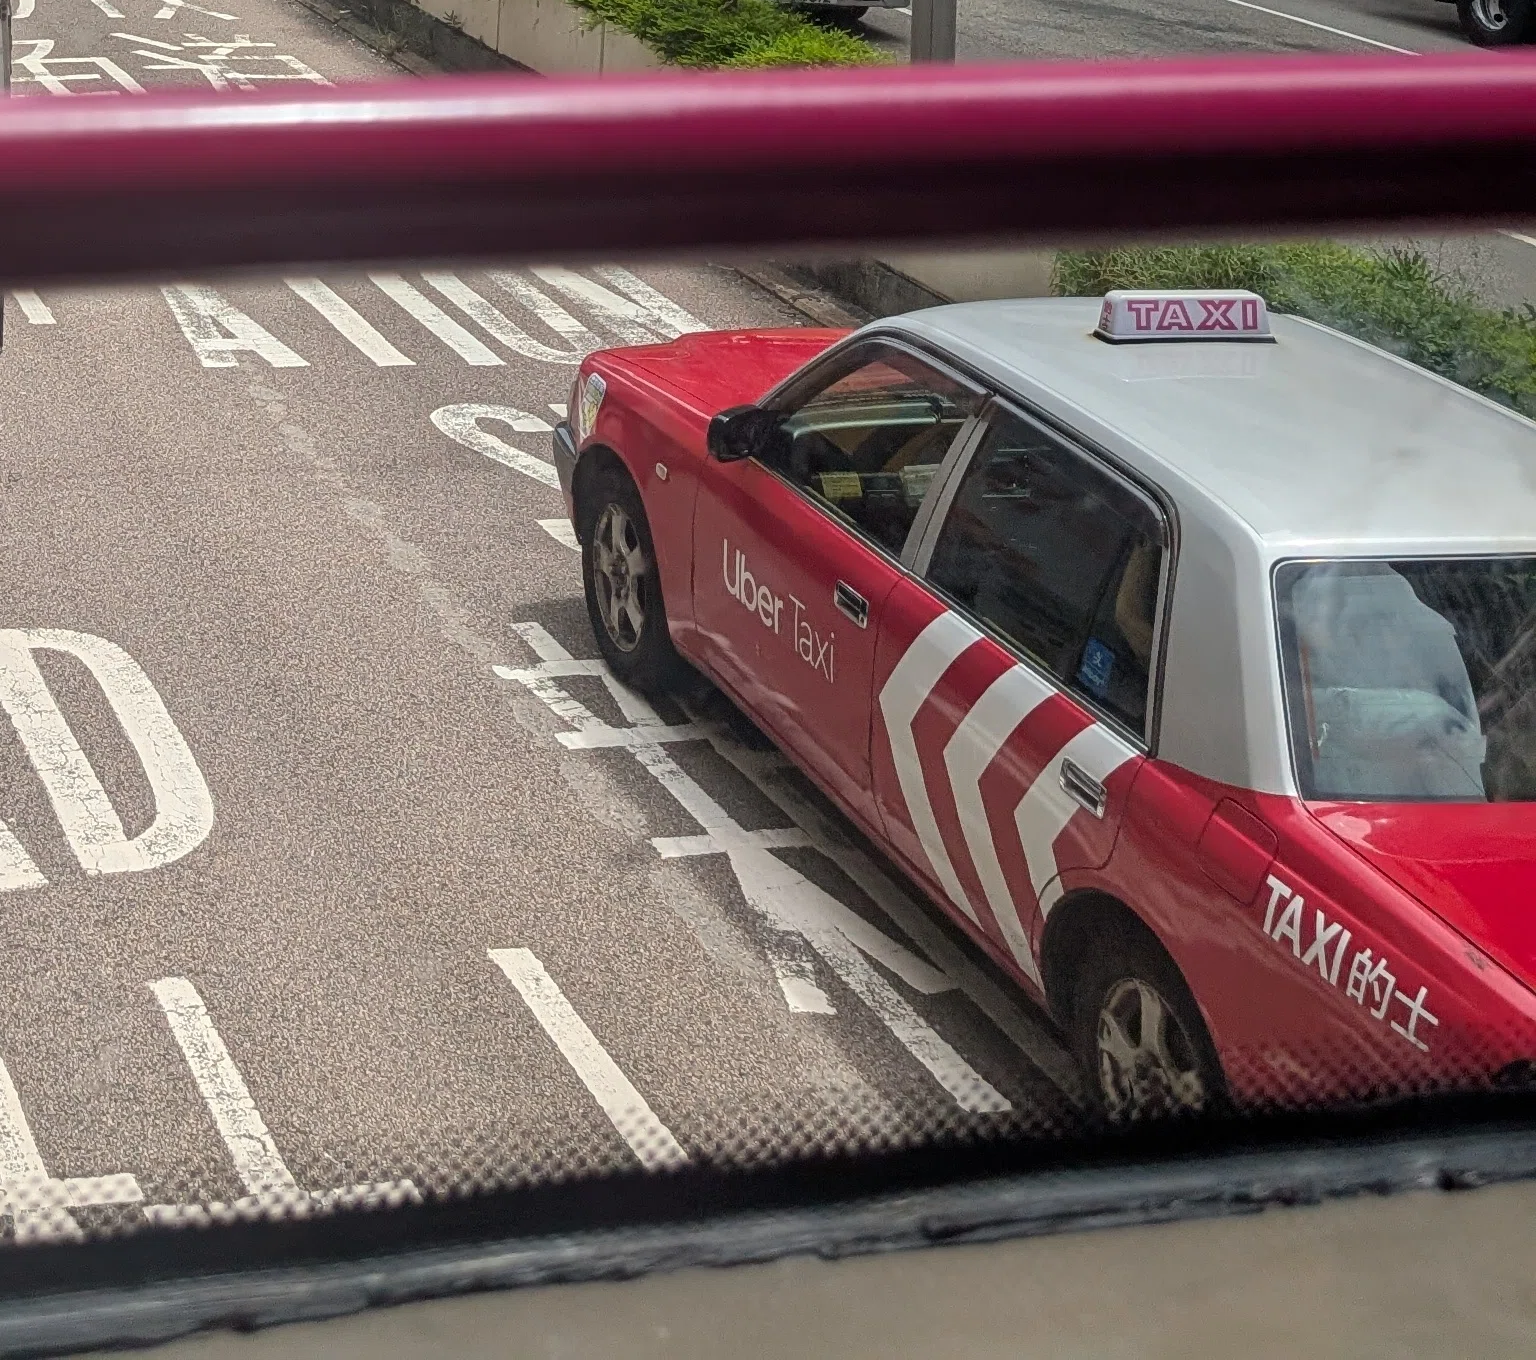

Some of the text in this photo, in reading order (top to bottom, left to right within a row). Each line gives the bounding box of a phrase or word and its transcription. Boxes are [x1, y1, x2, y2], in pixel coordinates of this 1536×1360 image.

[1127, 299, 1259, 331] TAXI
[723, 538, 835, 684] Uber Taxi
[1262, 873, 1352, 988] TAXI
[1345, 947, 1439, 1053] 的士
